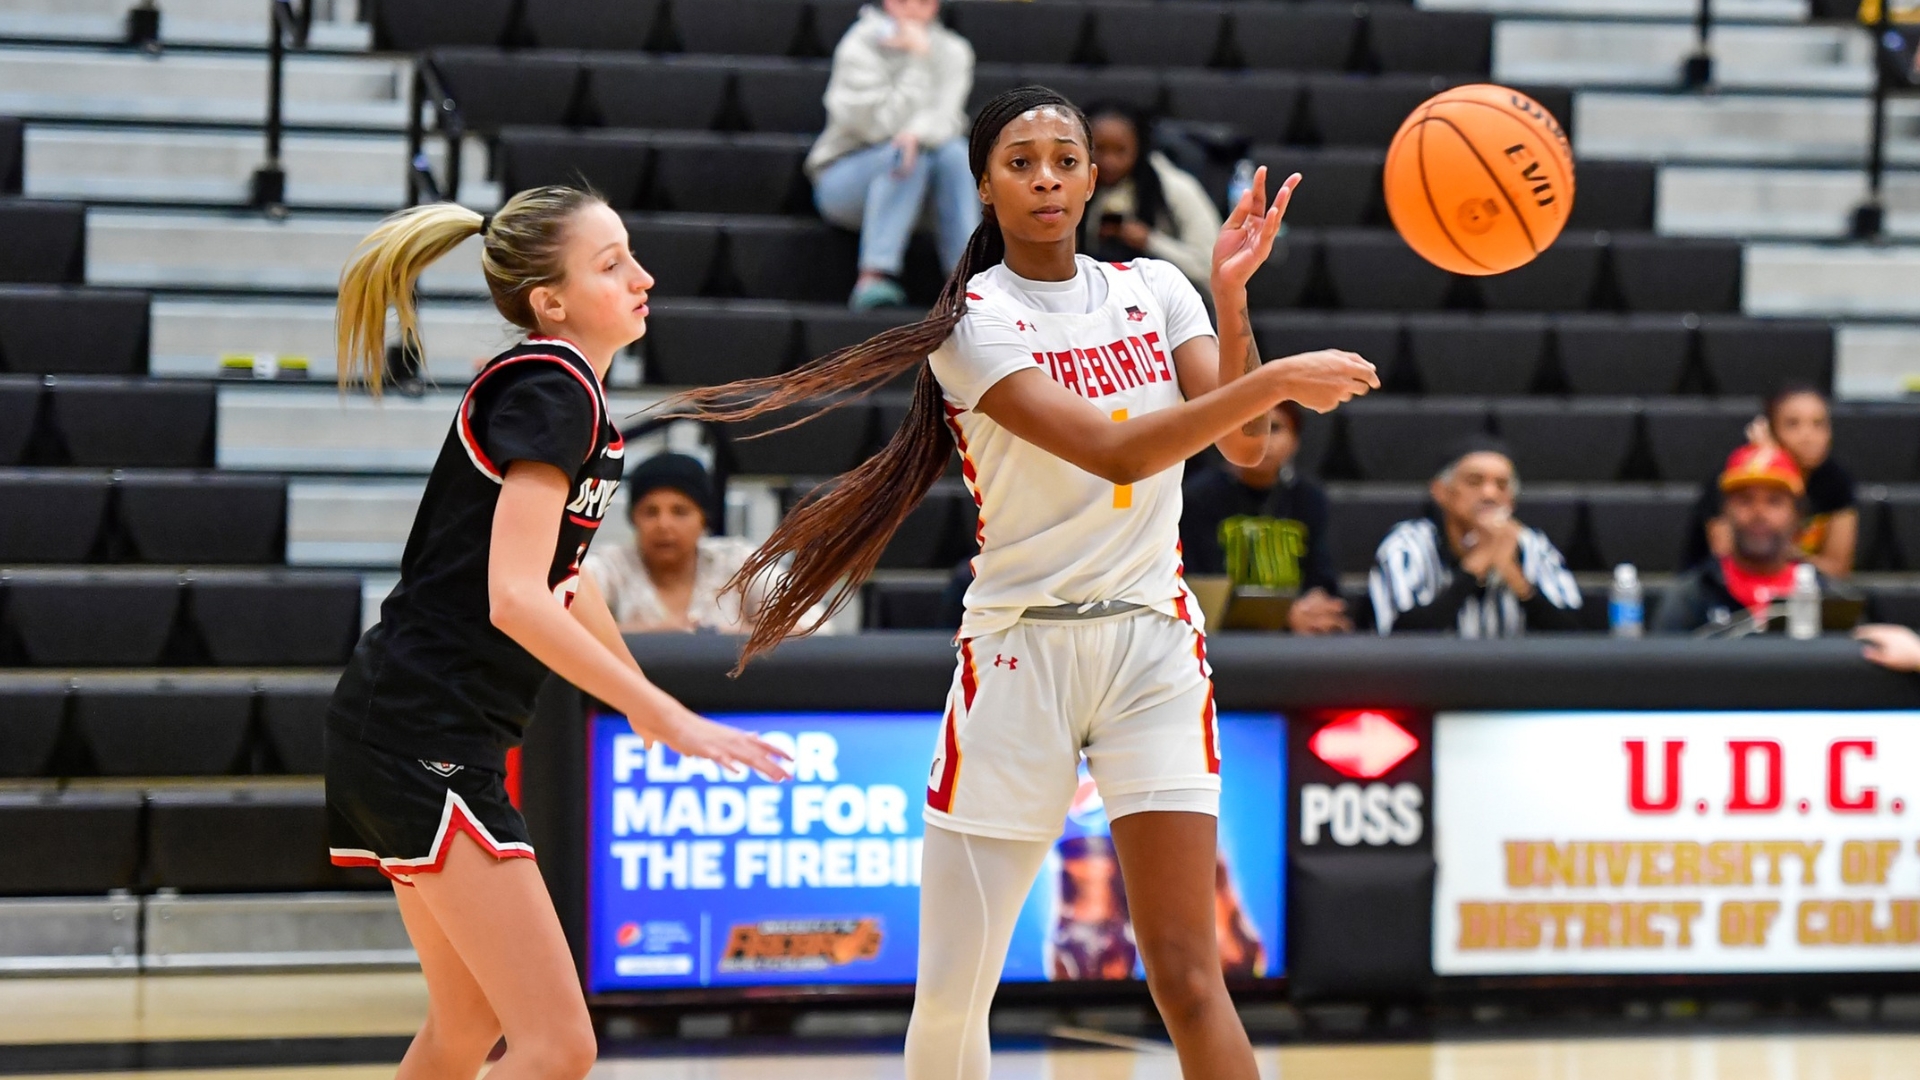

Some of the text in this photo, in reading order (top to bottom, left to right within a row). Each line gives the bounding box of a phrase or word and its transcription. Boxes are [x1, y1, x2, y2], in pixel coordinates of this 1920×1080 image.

[1031, 331, 1172, 398] IREBIRDS
[613, 731, 839, 783] FLAOR
[612, 784, 907, 836] MADE FOR
[1300, 782, 1424, 846] POSS
[610, 838, 725, 890] THE
[1503, 840, 1824, 887] UNIVERSITY
[1841, 840, 1901, 886] OF
[1457, 901, 1703, 949] DISTRICT
[1719, 901, 1781, 947] OF
